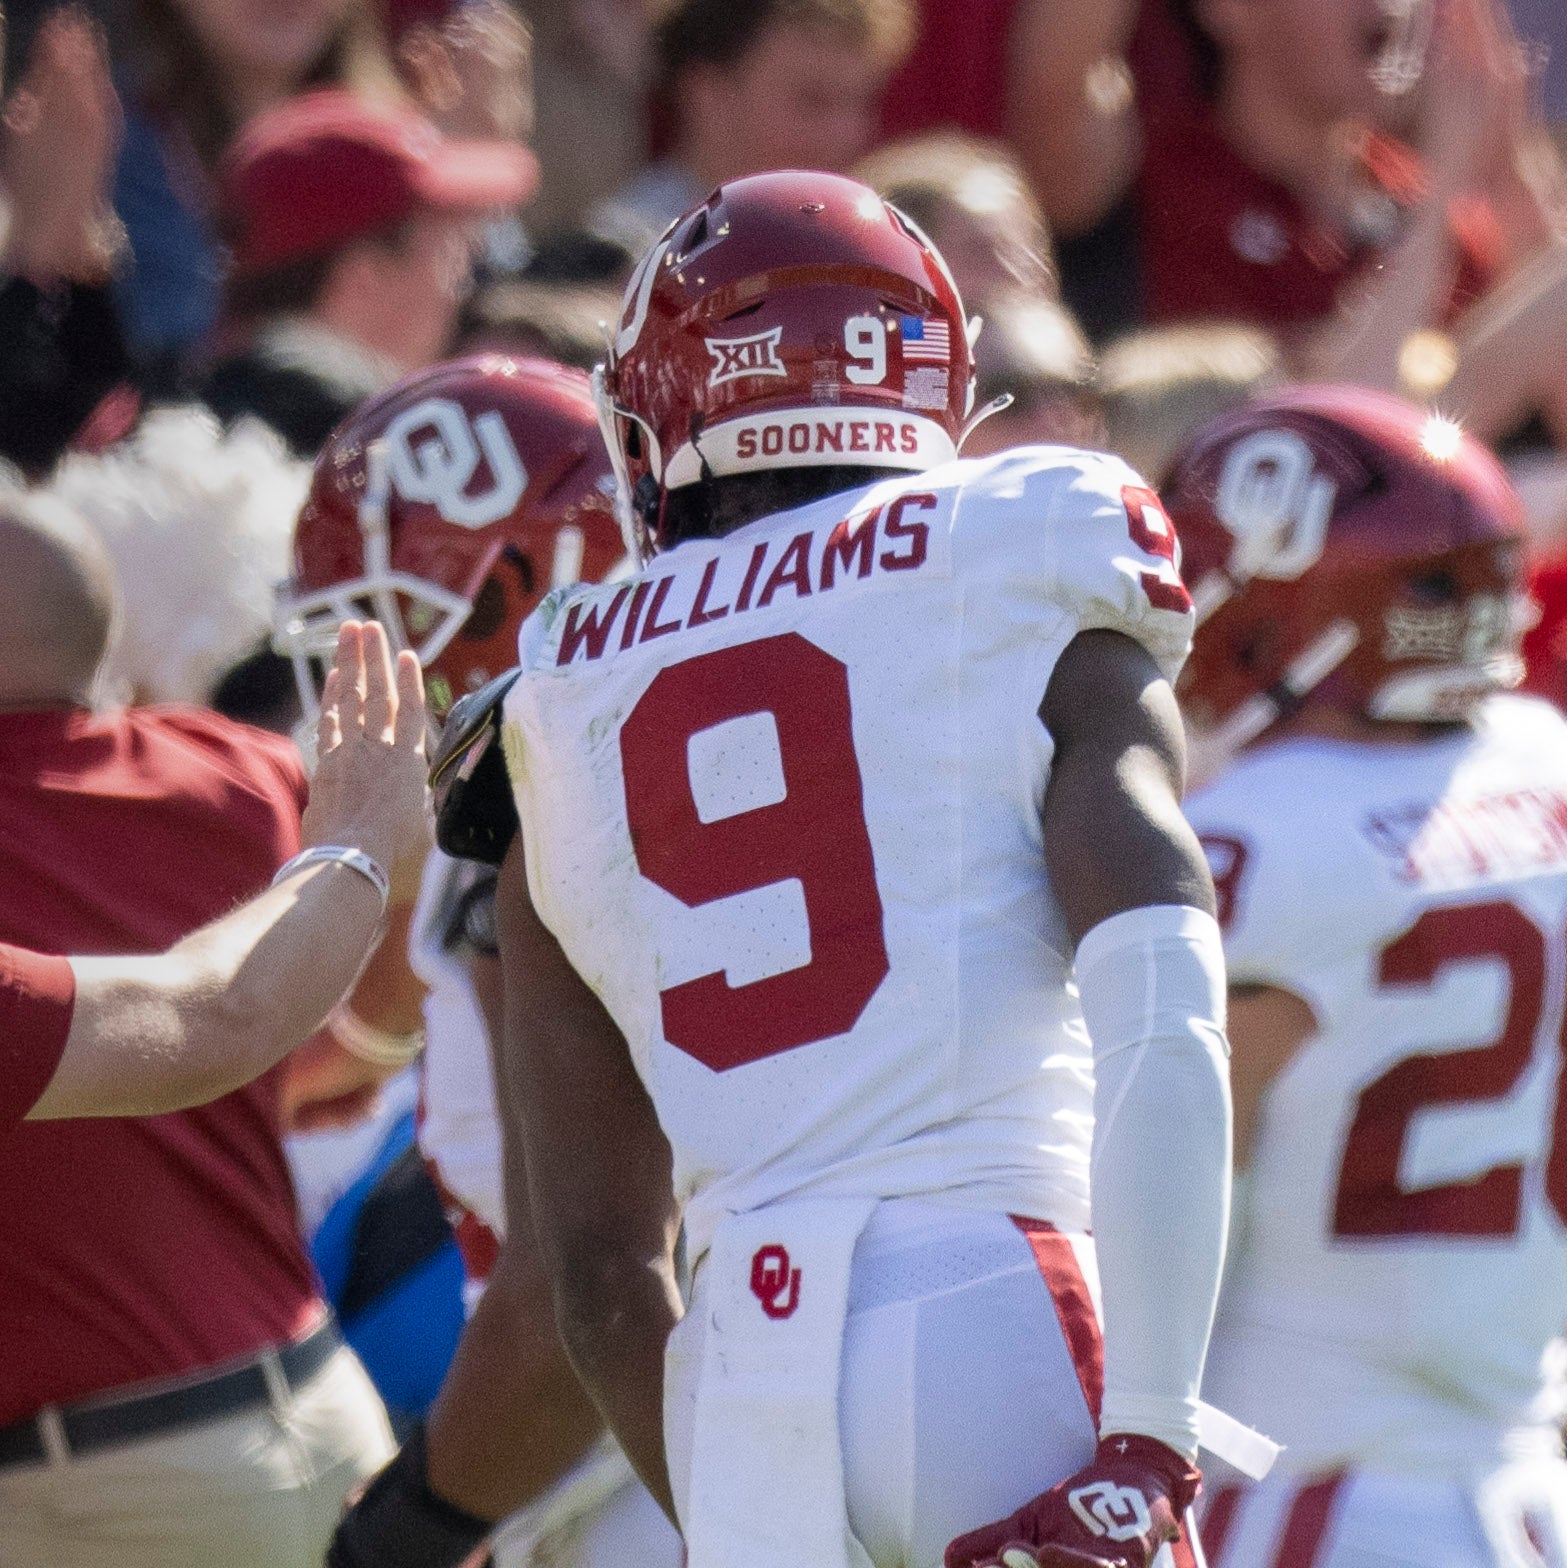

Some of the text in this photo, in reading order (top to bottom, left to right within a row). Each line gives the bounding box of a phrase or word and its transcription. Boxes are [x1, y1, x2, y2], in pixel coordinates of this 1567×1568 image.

[844, 316, 887, 384] 9
[384, 399, 529, 530] OU
[736, 423, 919, 460] SOONERS
[555, 494, 939, 667] WILLIAMS
[1120, 484, 1193, 613] 9
[620, 632, 890, 1073] 9
[750, 1244, 802, 1320] OU
